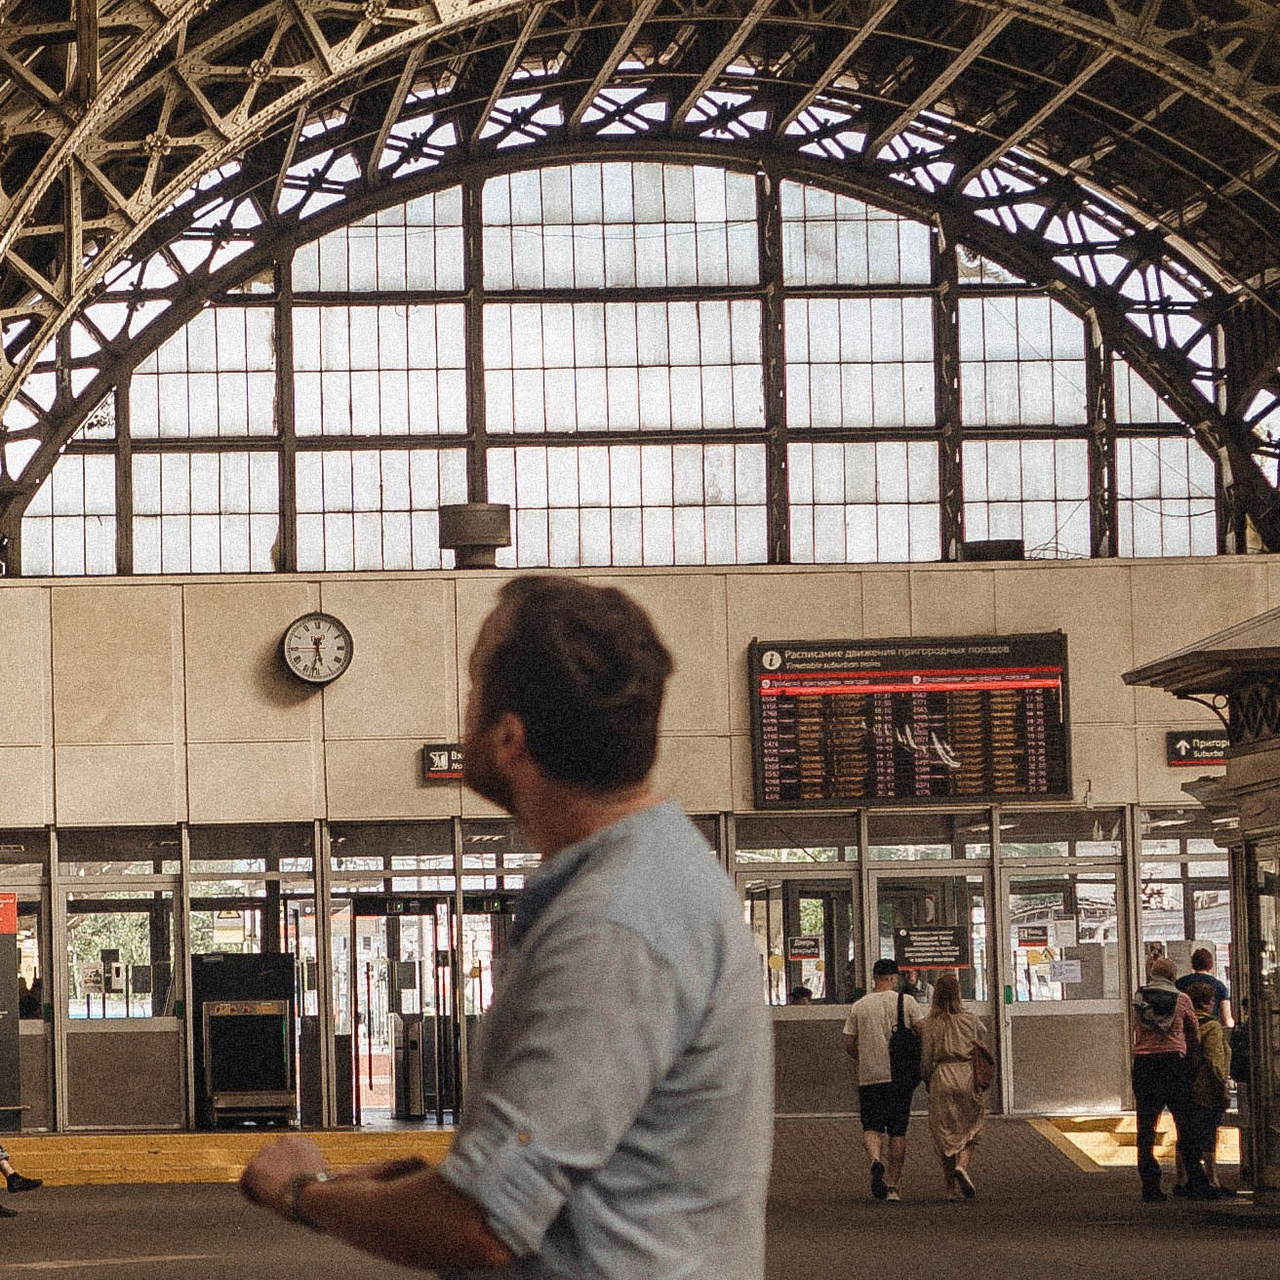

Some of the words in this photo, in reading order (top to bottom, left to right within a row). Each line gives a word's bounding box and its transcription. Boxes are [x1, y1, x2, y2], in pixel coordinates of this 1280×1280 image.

[784, 650, 843, 660] Расписание
[844, 649, 896, 658] движения
[897, 646, 965, 658] пригородных
[968, 645, 1010, 654] поездов
[1192, 739, 1230, 749] Пригор
[1193, 750, 1224, 758] Suburba
